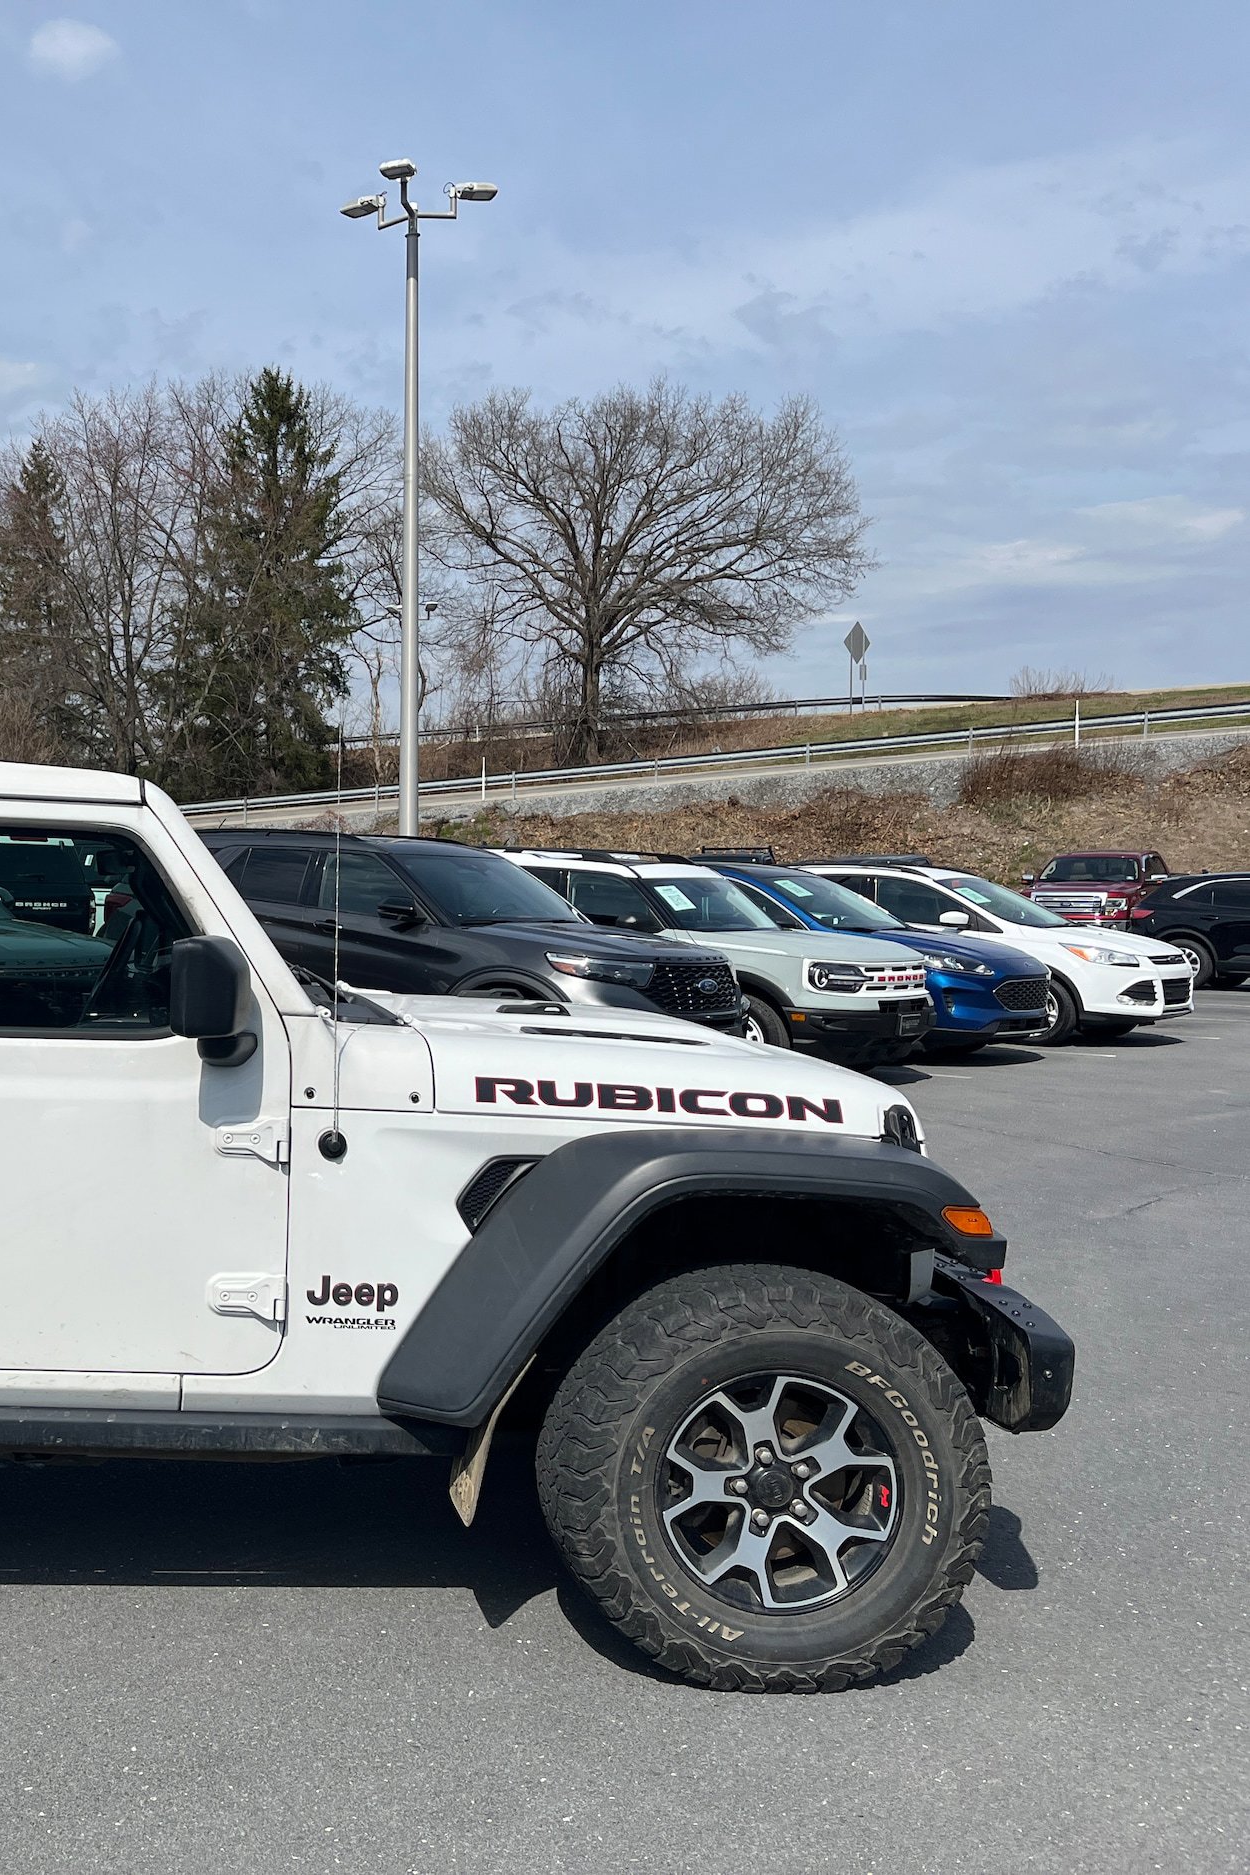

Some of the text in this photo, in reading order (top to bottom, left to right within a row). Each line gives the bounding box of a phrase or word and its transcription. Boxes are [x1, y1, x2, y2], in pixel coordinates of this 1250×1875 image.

[475, 1076, 844, 1124] RUBICON
[306, 1274, 399, 1312] Jeep
[305, 1315, 396, 1326] WRANGLER
[630, 1426, 656, 1476] T/A
[844, 1360, 943, 1546] BFGoodrich
